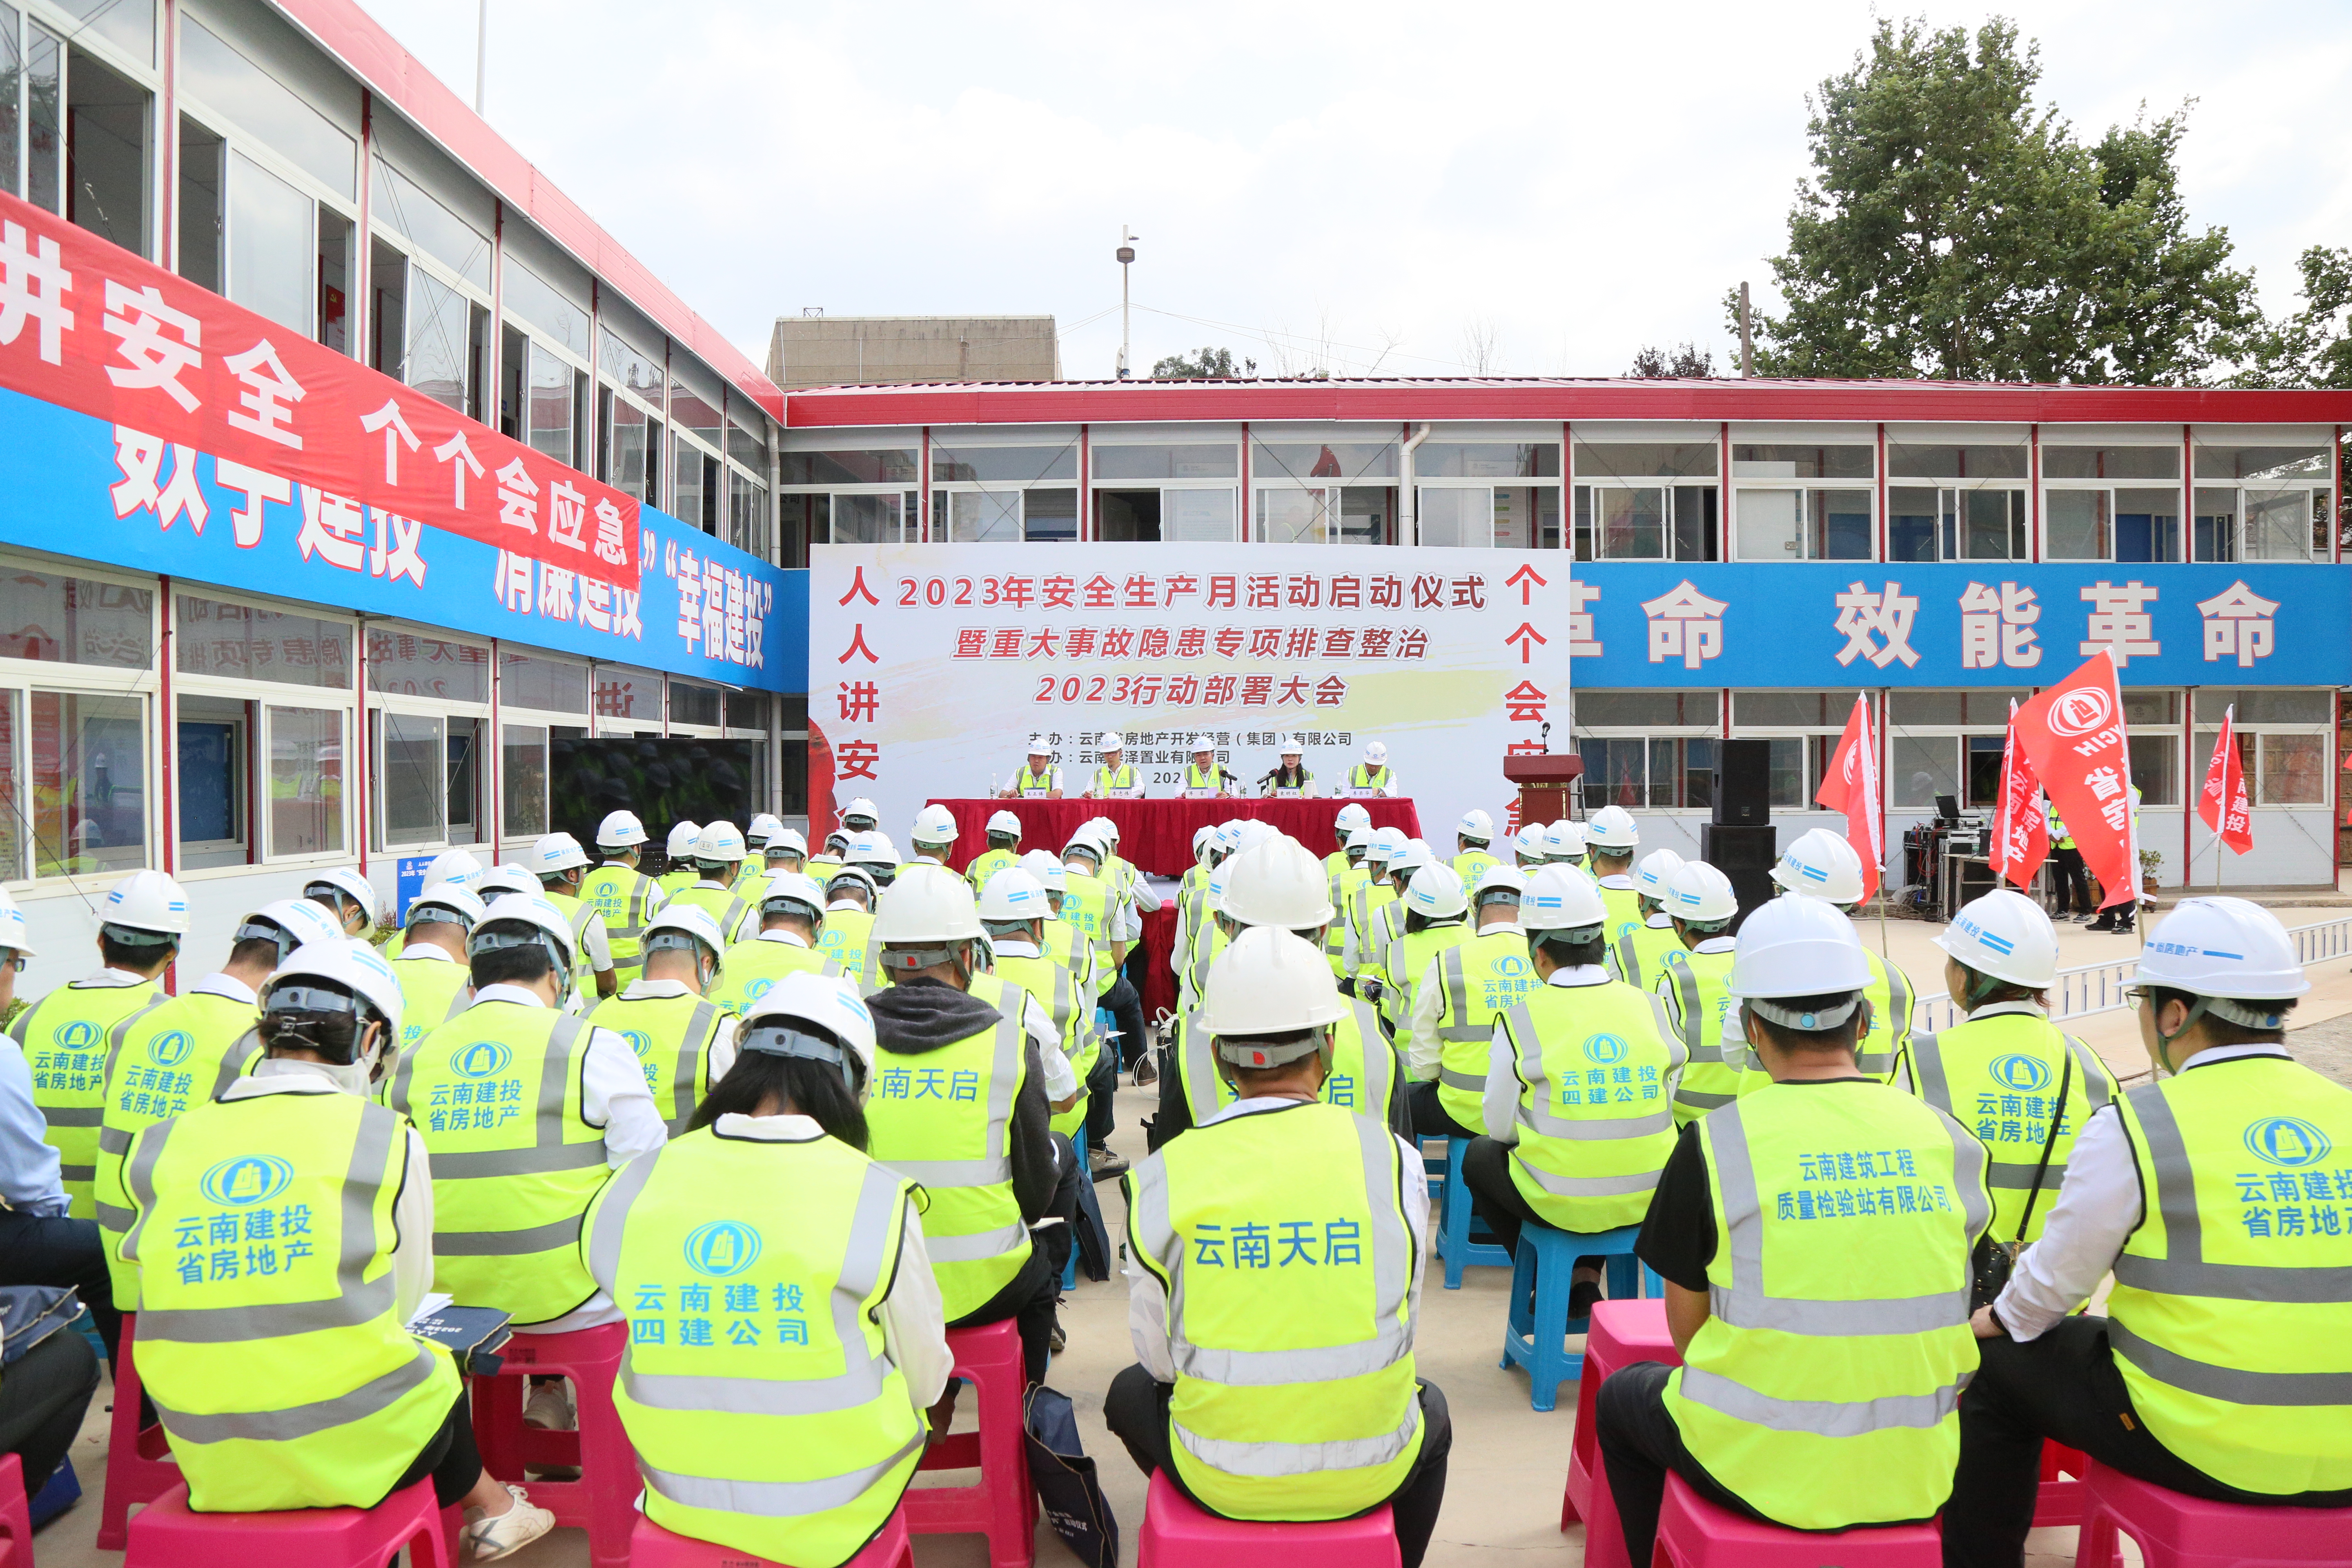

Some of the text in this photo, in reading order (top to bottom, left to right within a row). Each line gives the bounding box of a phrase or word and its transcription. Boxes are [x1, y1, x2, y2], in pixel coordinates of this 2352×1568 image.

[360, 398, 628, 566] 个个会应急
[898, 573, 1488, 611] 2023年安全生产月活动启动仪式
[1833, 579, 2281, 669] 效能革命
[952, 626, 1431, 659] 暨重大事故隐患专项排查整治
[837, 566, 880, 813] 人人讲安
[1034, 673, 1348, 706] 2023行动部署大会
[35, 1051, 105, 1072] 云南建投
[1561, 1065, 1658, 1087] 云南建投
[34, 1071, 102, 1091] 省房地产
[125, 1065, 193, 1096] 云南建投
[429, 1080, 523, 1107] 云南建投
[871, 1067, 979, 1102] 南天启
[1562, 1084, 1659, 1105] 四建公司
[120, 1089, 187, 1119] 省房地产
[429, 1105, 521, 1132] 省房地产
[1798, 1149, 1918, 1182] 云南建筑工程
[1777, 1185, 1953, 1221] 质量检验站有限公司
[173, 1204, 313, 1249] 云南建投
[1194, 1217, 1362, 1269] 云南天启
[176, 1240, 314, 1285] 省房地产
[634, 1283, 805, 1314] 云南建投
[632, 1318, 810, 1347] 四建公司
